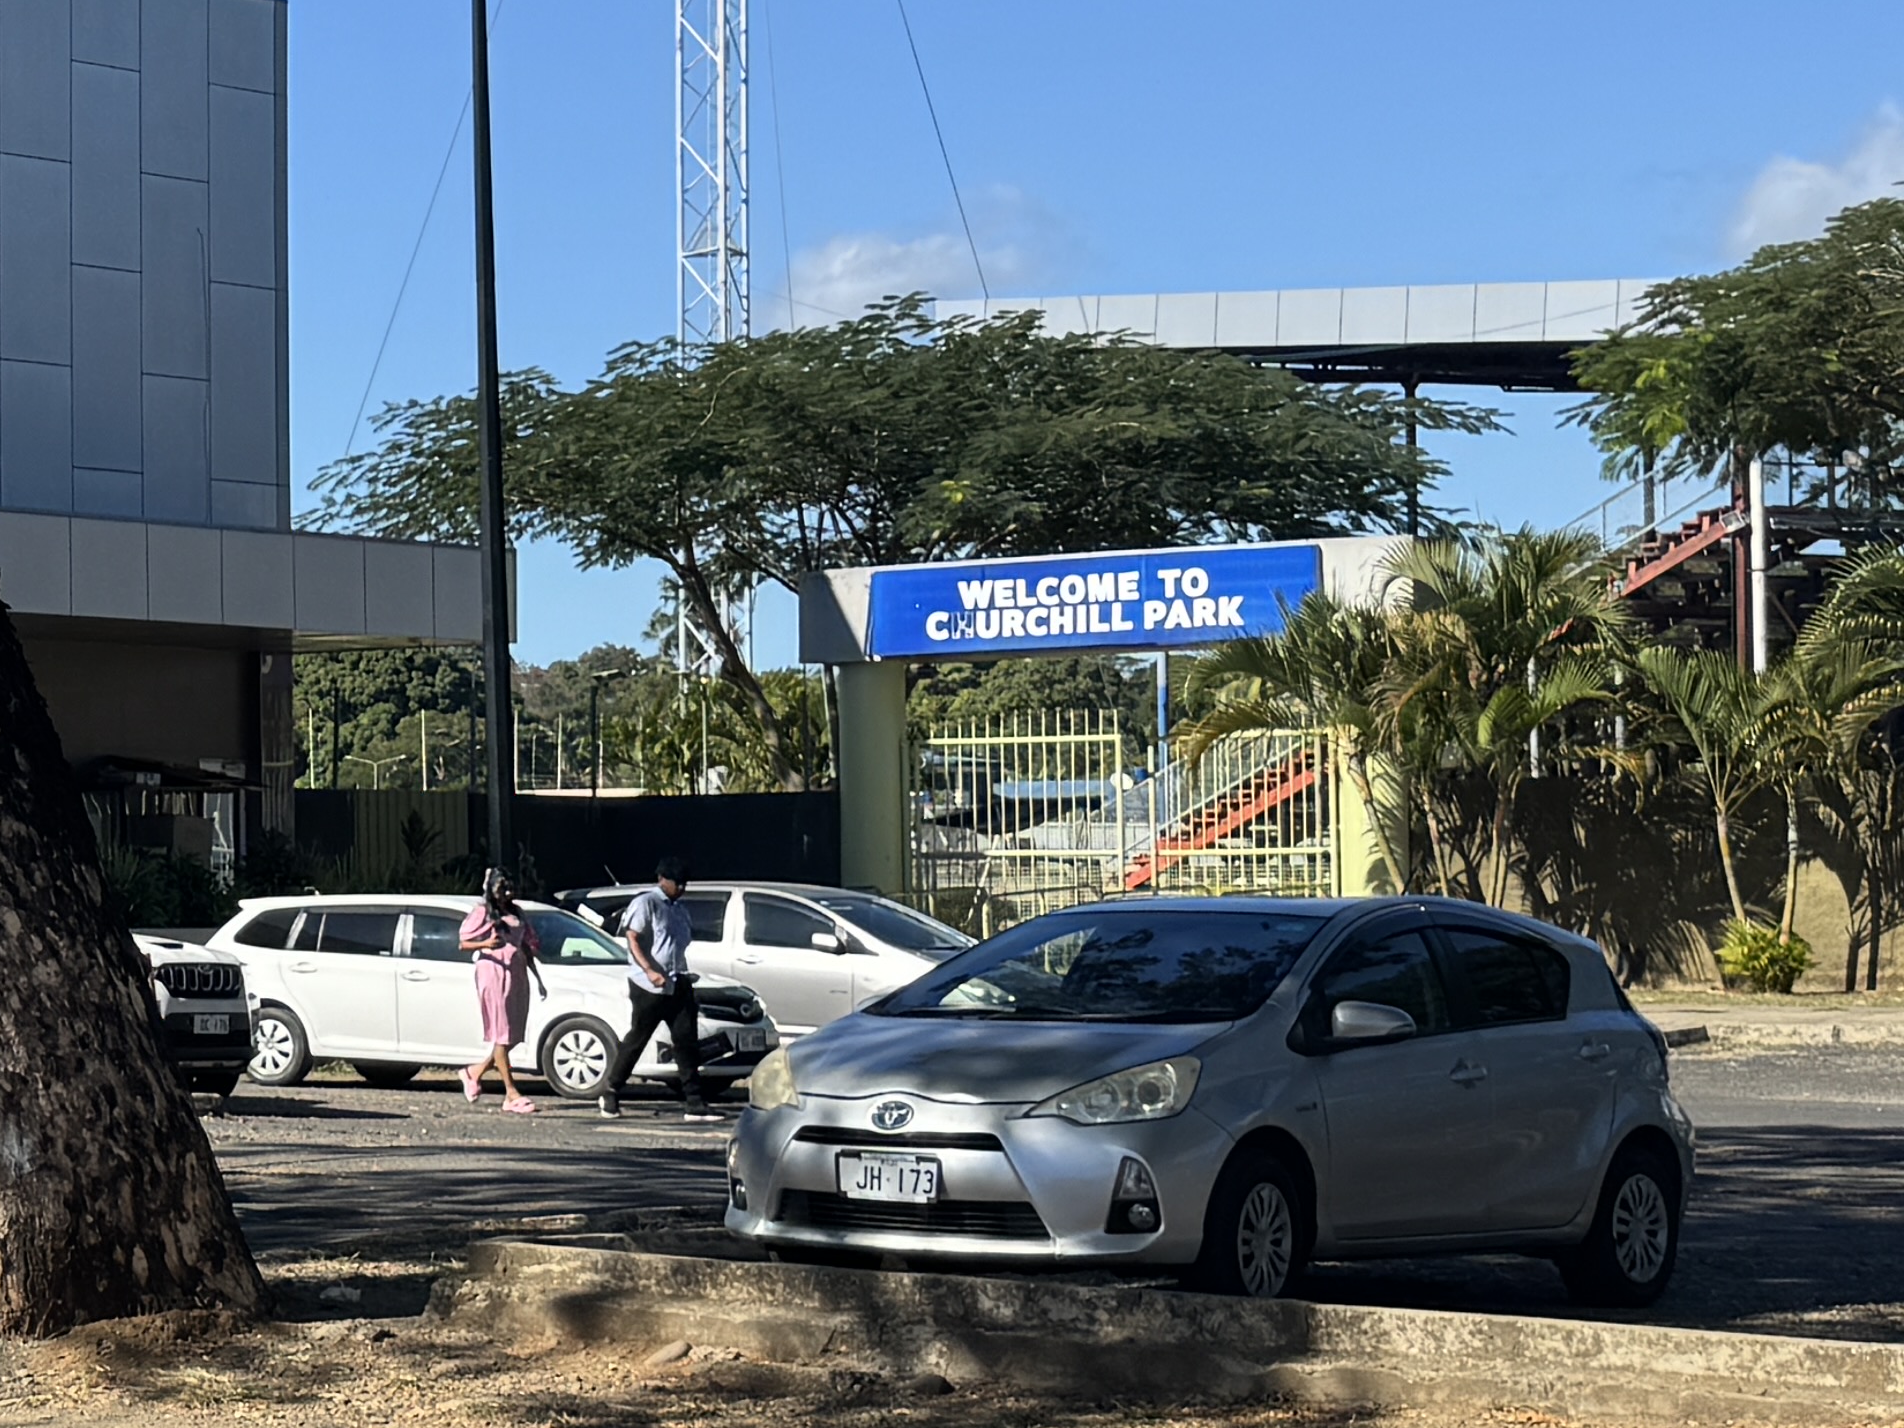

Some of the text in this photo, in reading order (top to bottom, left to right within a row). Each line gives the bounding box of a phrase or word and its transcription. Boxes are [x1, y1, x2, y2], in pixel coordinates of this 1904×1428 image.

[957, 567, 1209, 610] WELCOME TO
[1143, 595, 1244, 630] PARK
[856, 1165, 934, 1194] JH 173
